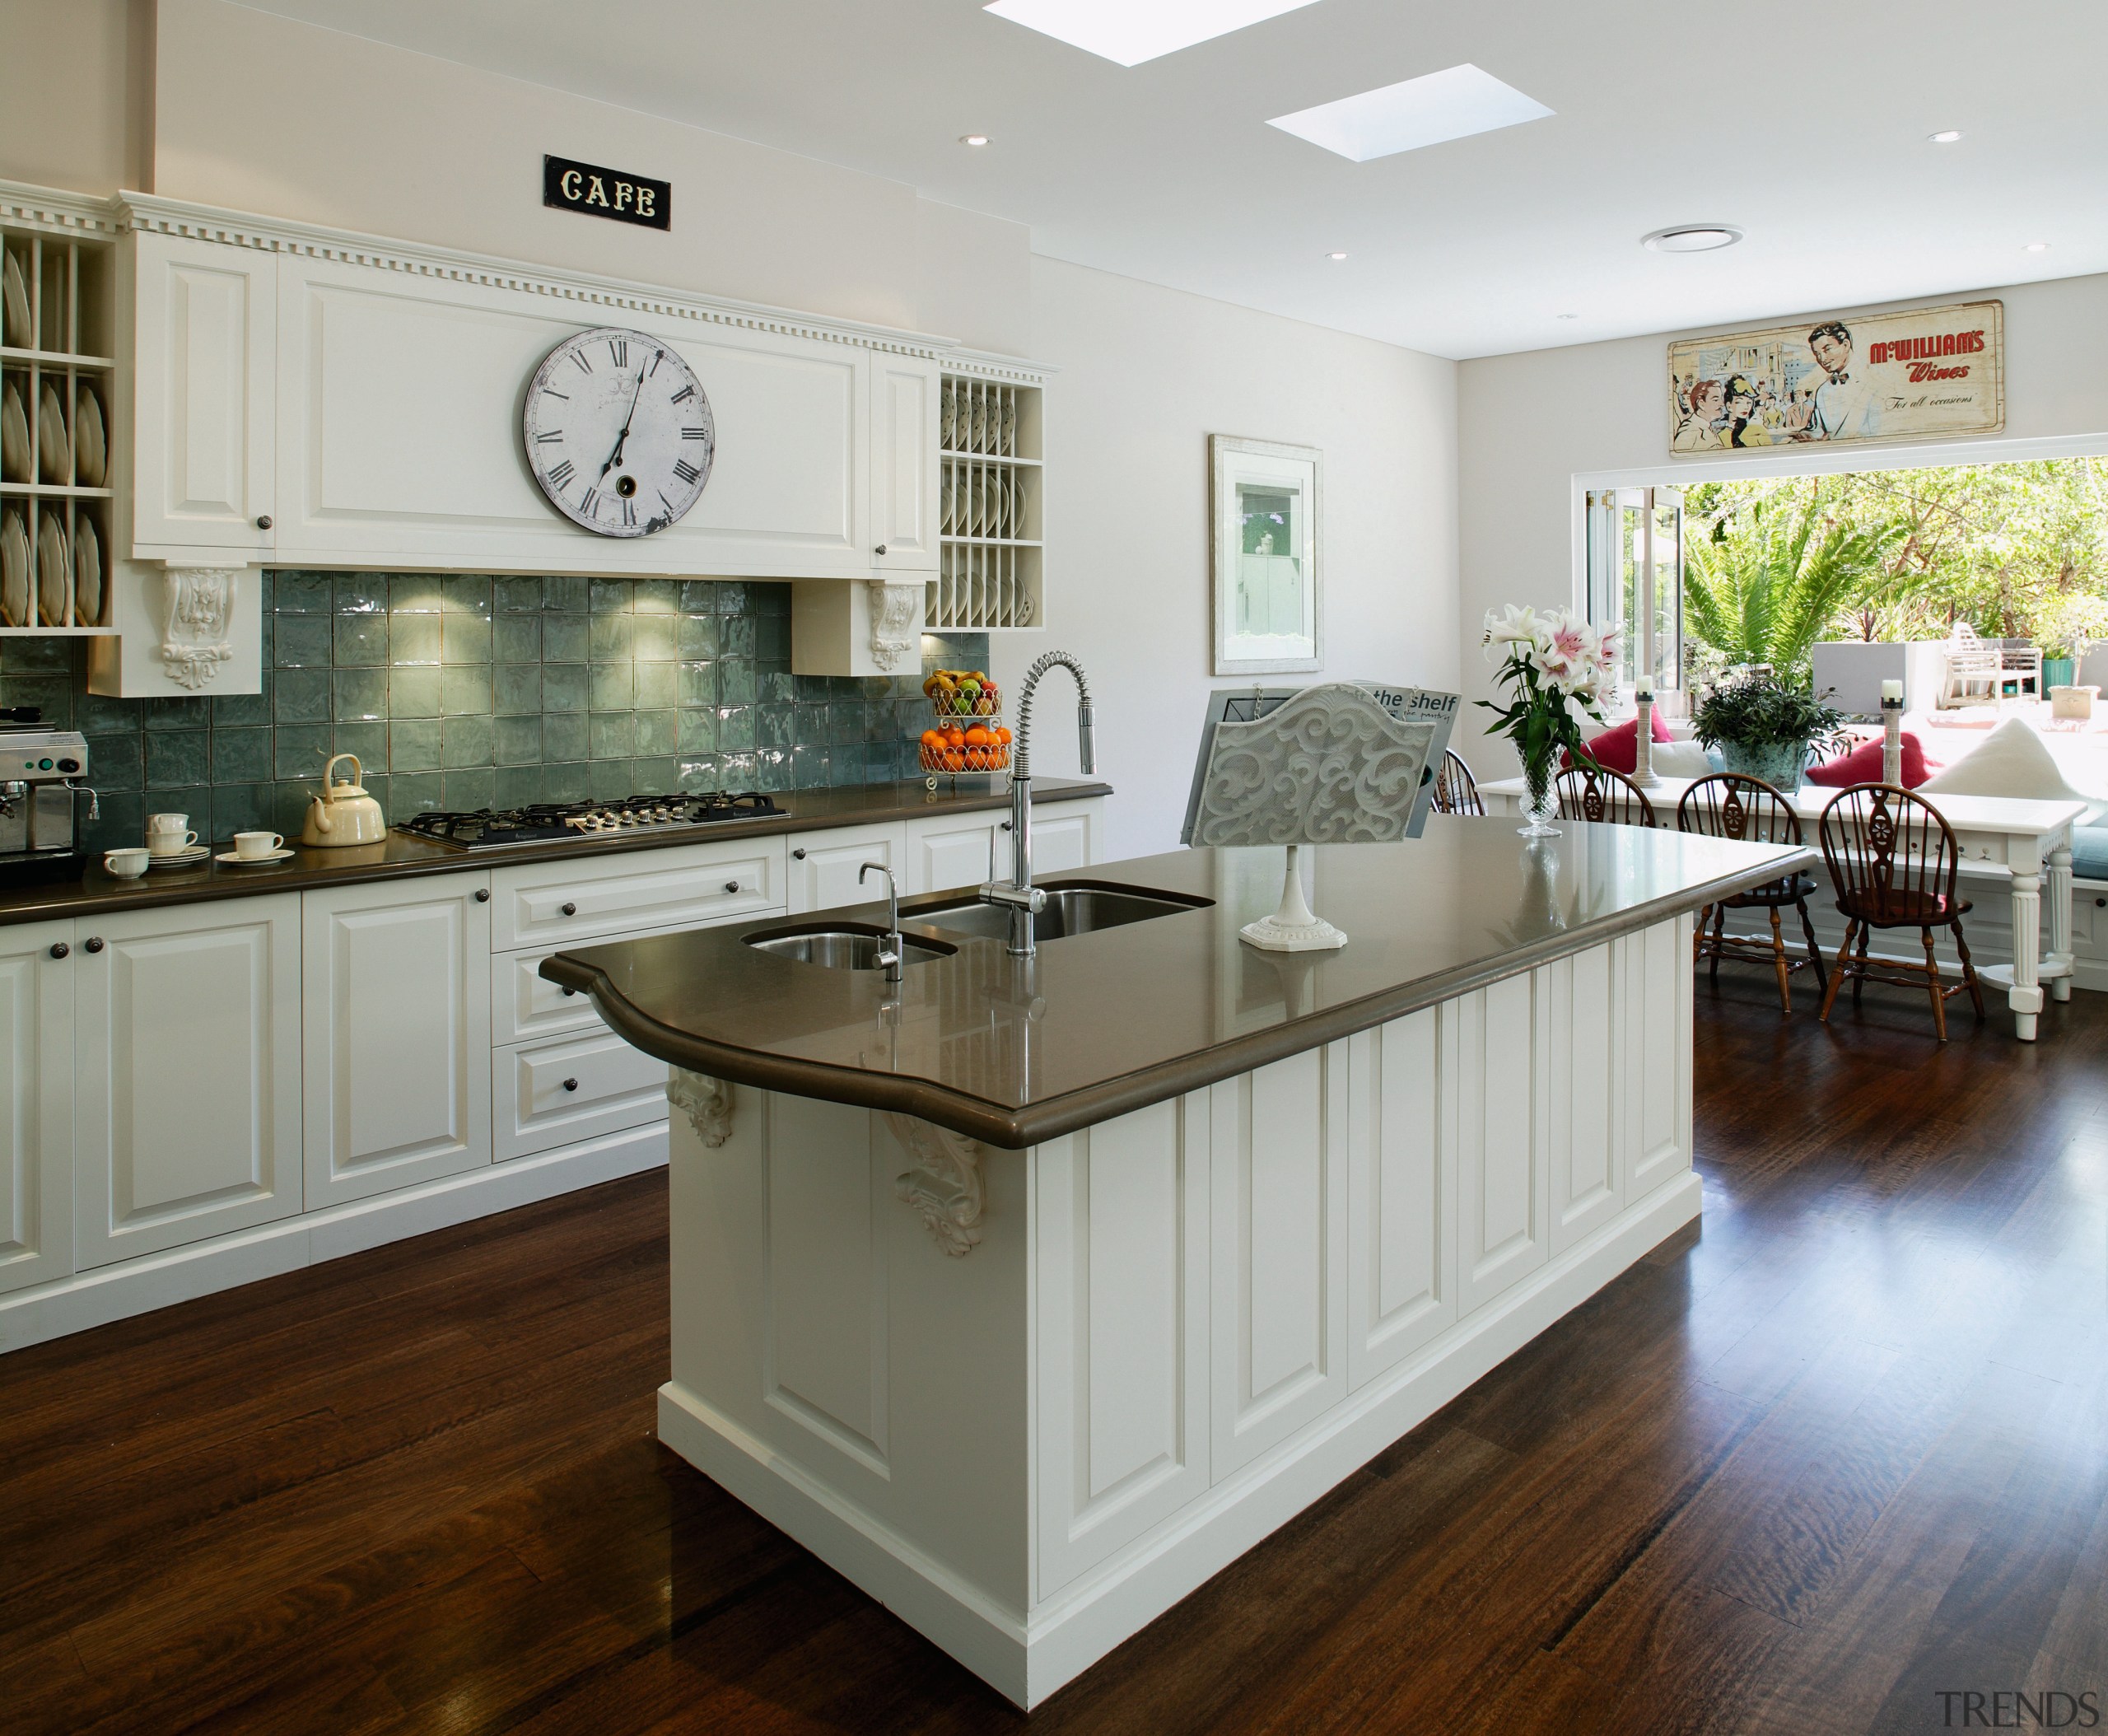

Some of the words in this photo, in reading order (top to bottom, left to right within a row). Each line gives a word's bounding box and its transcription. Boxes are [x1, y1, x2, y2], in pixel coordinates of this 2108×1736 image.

[560, 170, 655, 217] CAFE
[1905, 361, 1970, 383] Wines
[1884, 396, 1908, 411] For
[1910, 395, 1928, 408] all
[1929, 394, 1973, 407] occasions
[1373, 689, 1402, 707] the
[1410, 693, 1457, 712] shelf
